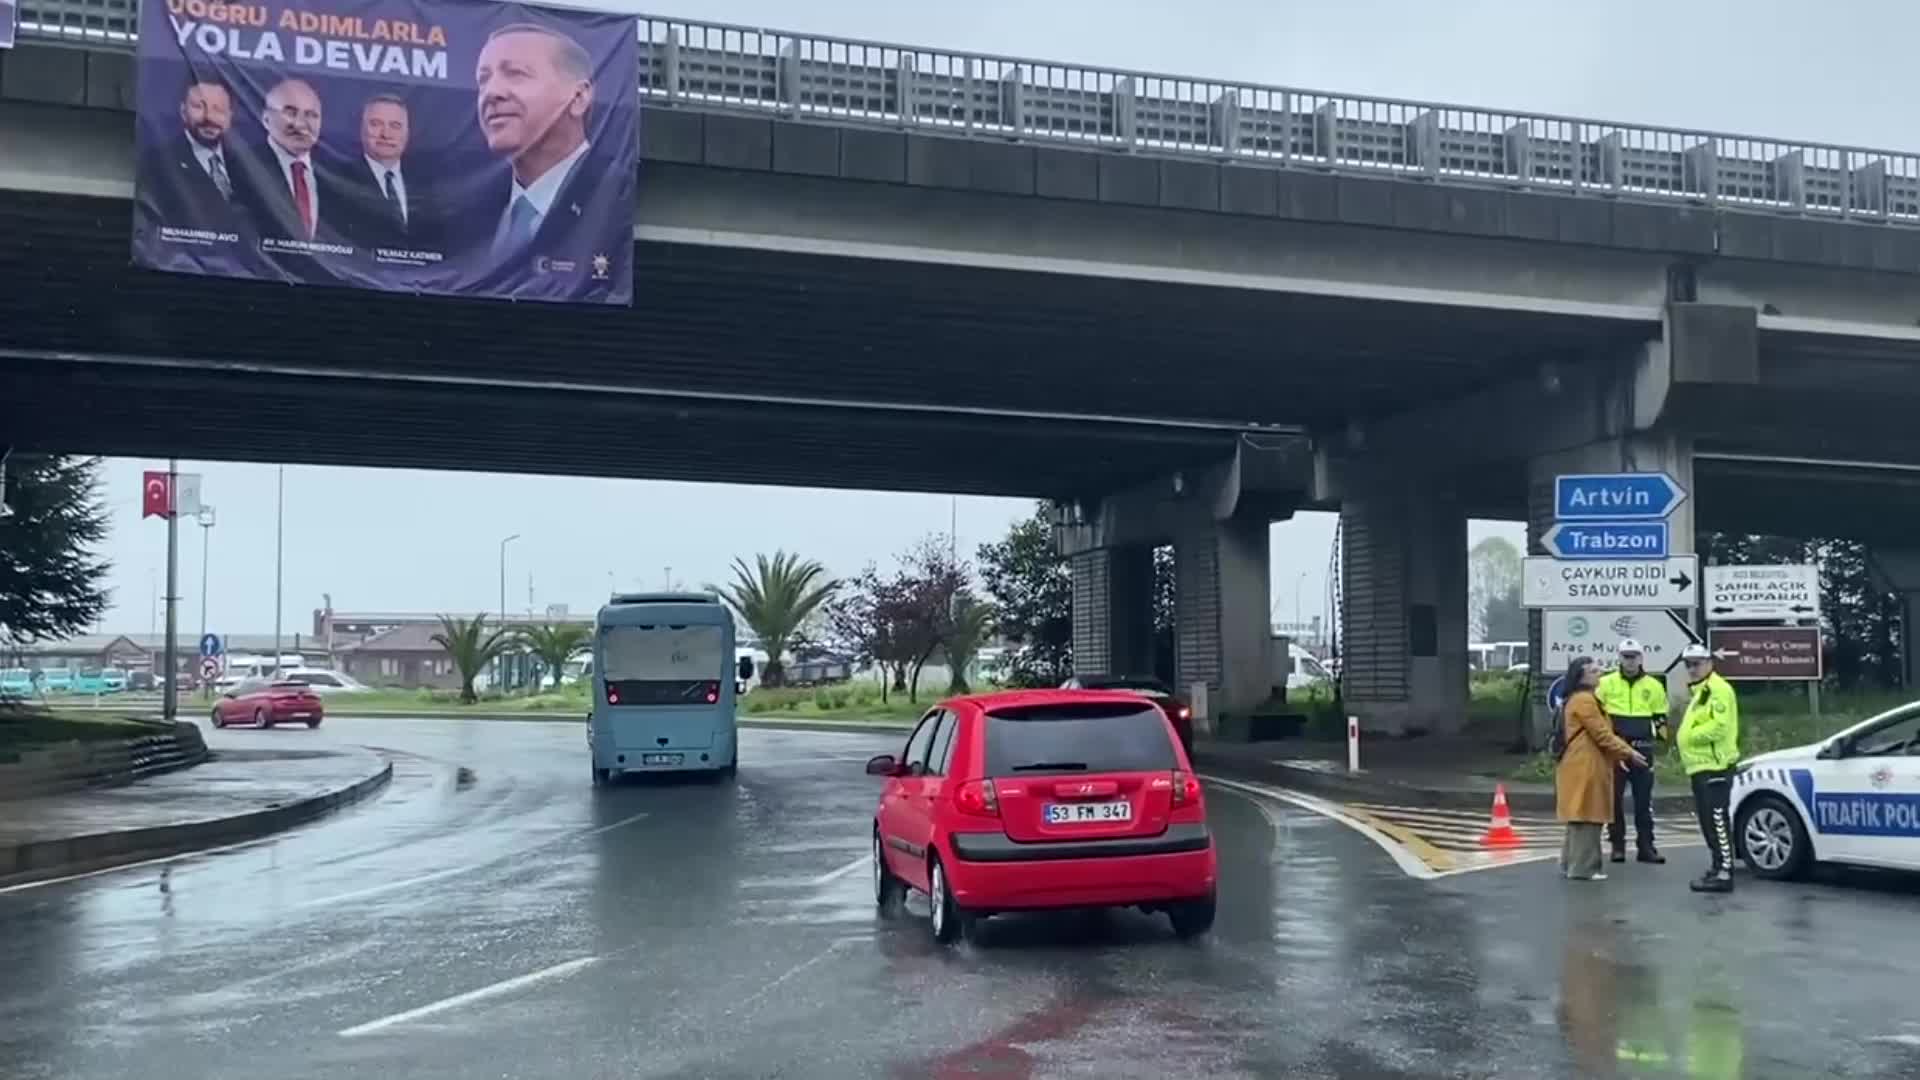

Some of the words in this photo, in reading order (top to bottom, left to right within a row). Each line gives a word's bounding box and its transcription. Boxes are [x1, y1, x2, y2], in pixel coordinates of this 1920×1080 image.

[279, 9, 447, 46] ADIMLARLA
[169, 15, 284, 61] YOLA
[295, 36, 448, 79] DEVAM
[1569, 486, 1649, 507] Artvin
[1570, 531, 1657, 549] Trabzon
[1561, 566, 1628, 581] ÇAYKUR
[1633, 564, 1667, 580] DİDİ
[1568, 583, 1659, 598] STADYUMU
[1551, 641, 1584, 654] Araç
[1052, 807, 1069, 821] 53
[1077, 805, 1095, 819] FM
[1103, 803, 1129, 818] 347
[1817, 799, 1881, 827] TRAFİK
